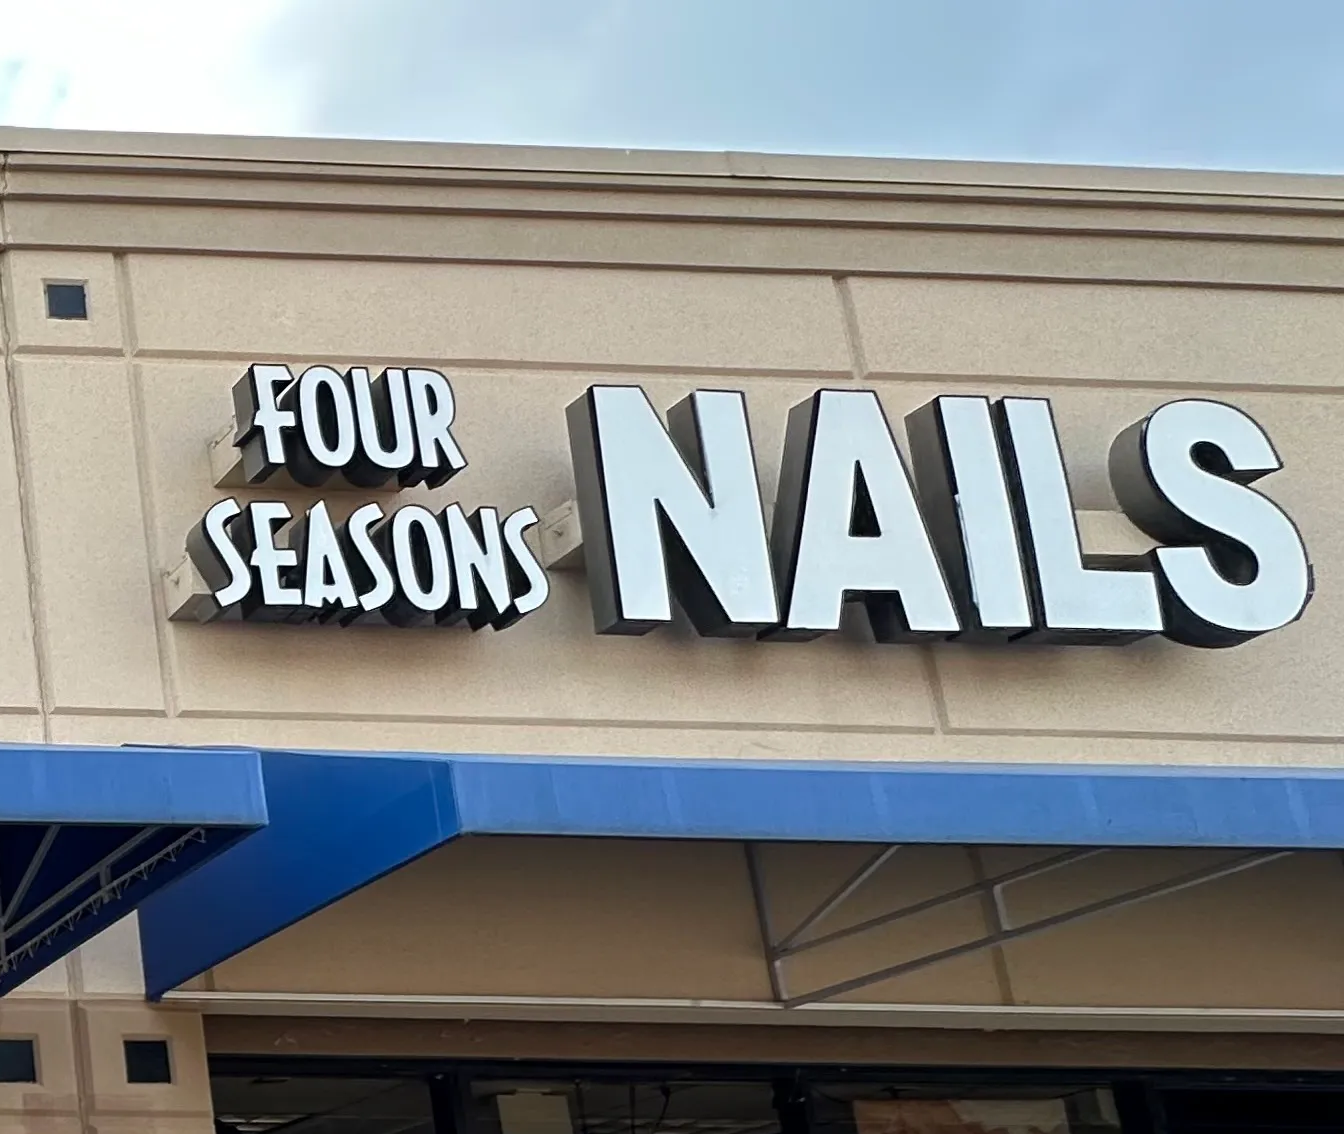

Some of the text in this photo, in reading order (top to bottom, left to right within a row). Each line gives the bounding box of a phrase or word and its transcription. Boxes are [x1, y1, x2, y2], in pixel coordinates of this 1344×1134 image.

[246, 363, 468, 490] FOUR
[209, 496, 551, 626] SEASONS
[580, 384, 1316, 648] NAILS
